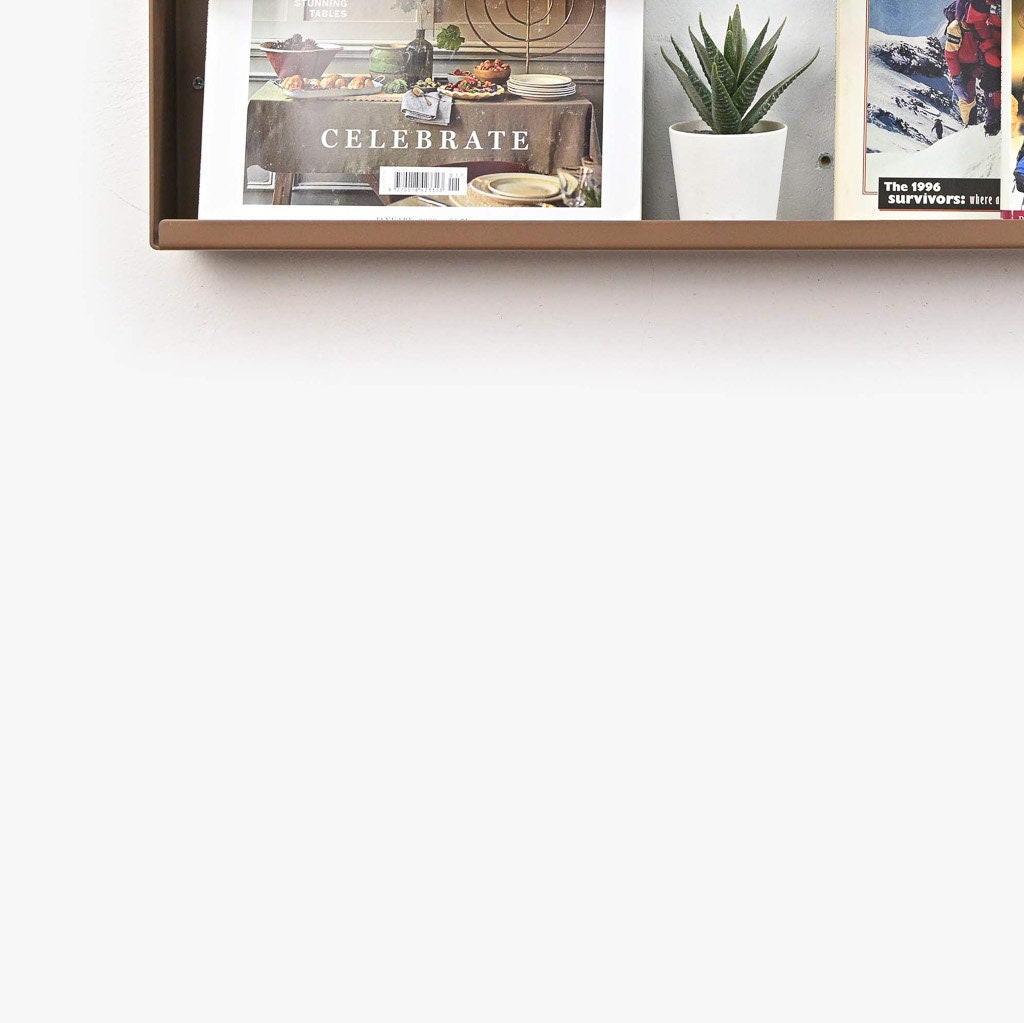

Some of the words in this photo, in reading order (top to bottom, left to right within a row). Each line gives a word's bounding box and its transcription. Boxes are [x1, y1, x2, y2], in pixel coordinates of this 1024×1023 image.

[293, 0, 348, 8] STUNNING
[309, 9, 348, 18] TABLES
[320, 128, 529, 150] CELEBRATE
[883, 181, 909, 192] The
[911, 181, 942, 192] 1996
[887, 192, 966, 205] survivors:
[969, 193, 993, 205] where
